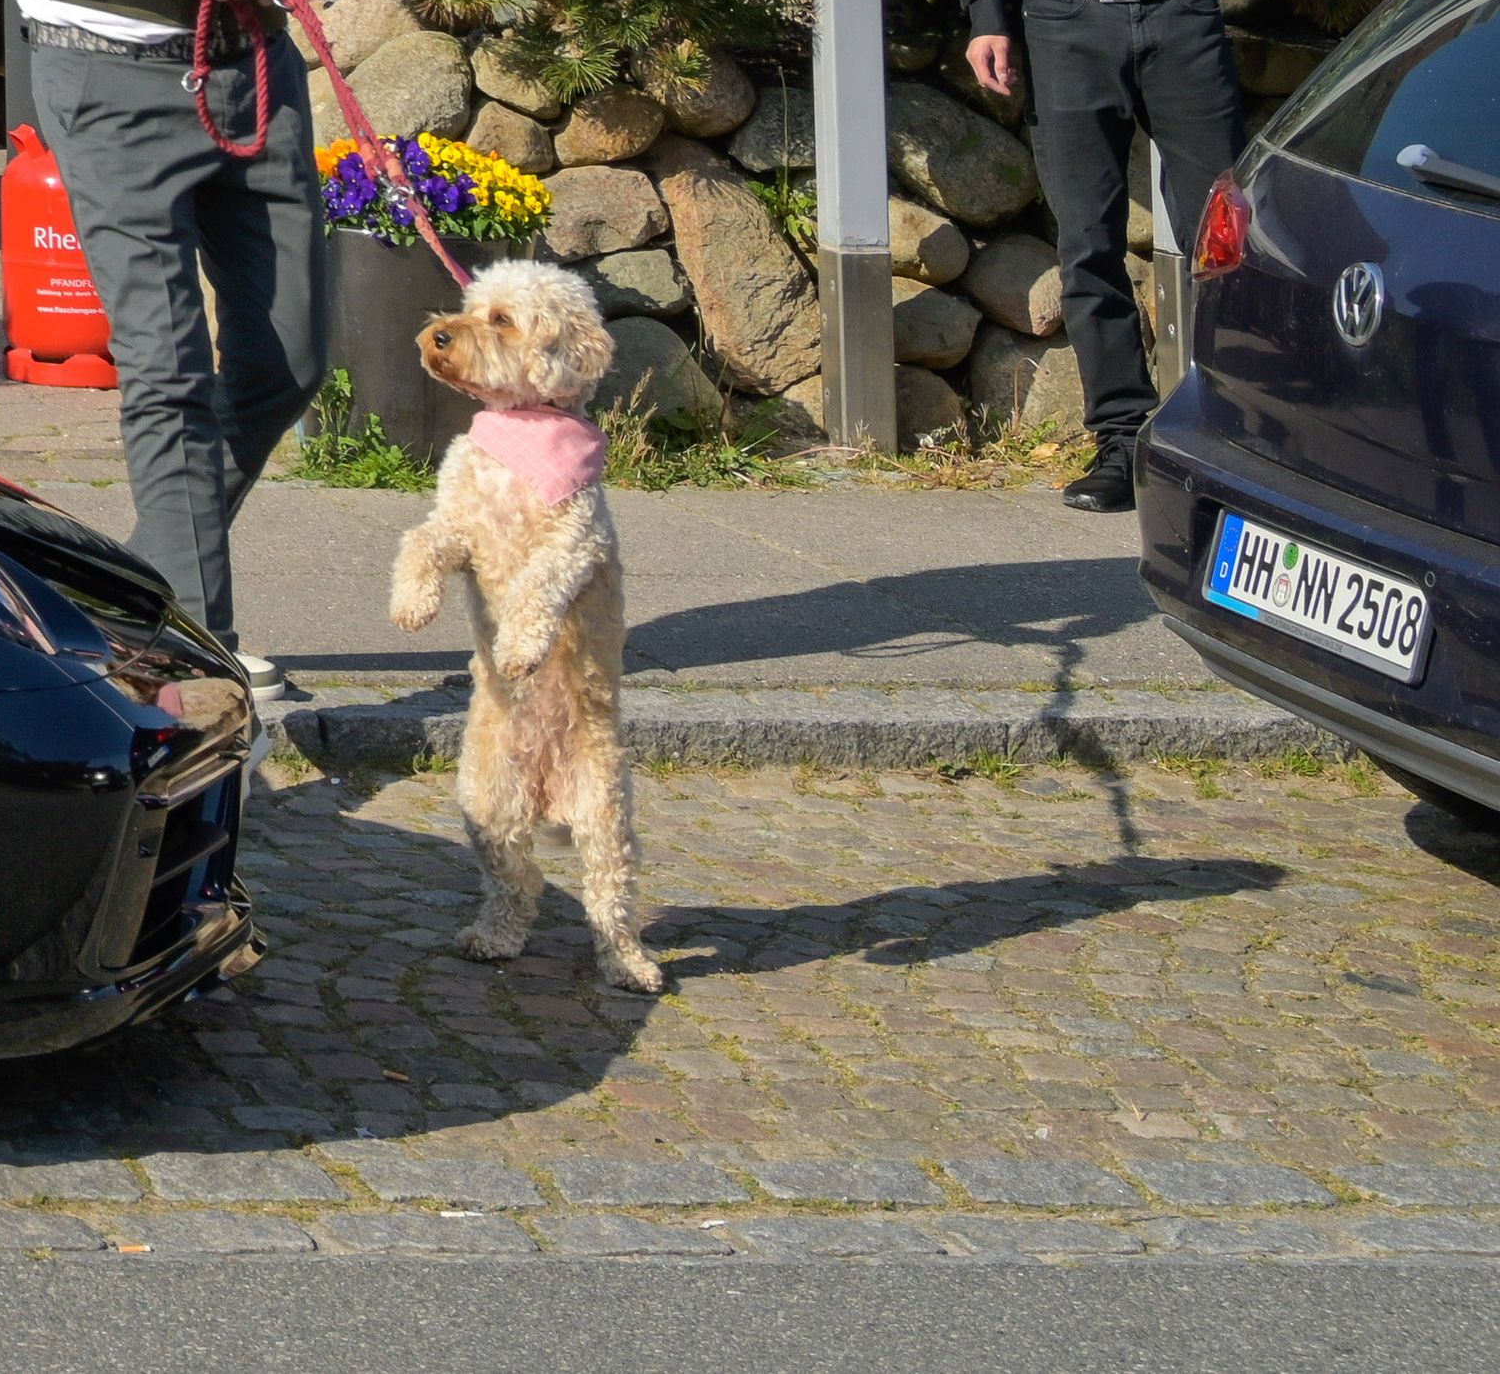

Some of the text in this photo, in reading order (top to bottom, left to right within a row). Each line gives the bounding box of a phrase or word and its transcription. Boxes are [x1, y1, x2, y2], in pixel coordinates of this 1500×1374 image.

[50, 278, 94, 287] PFANDFL
[1219, 561, 1229, 579] D
[1233, 530, 1423, 656] HH NN 2508
